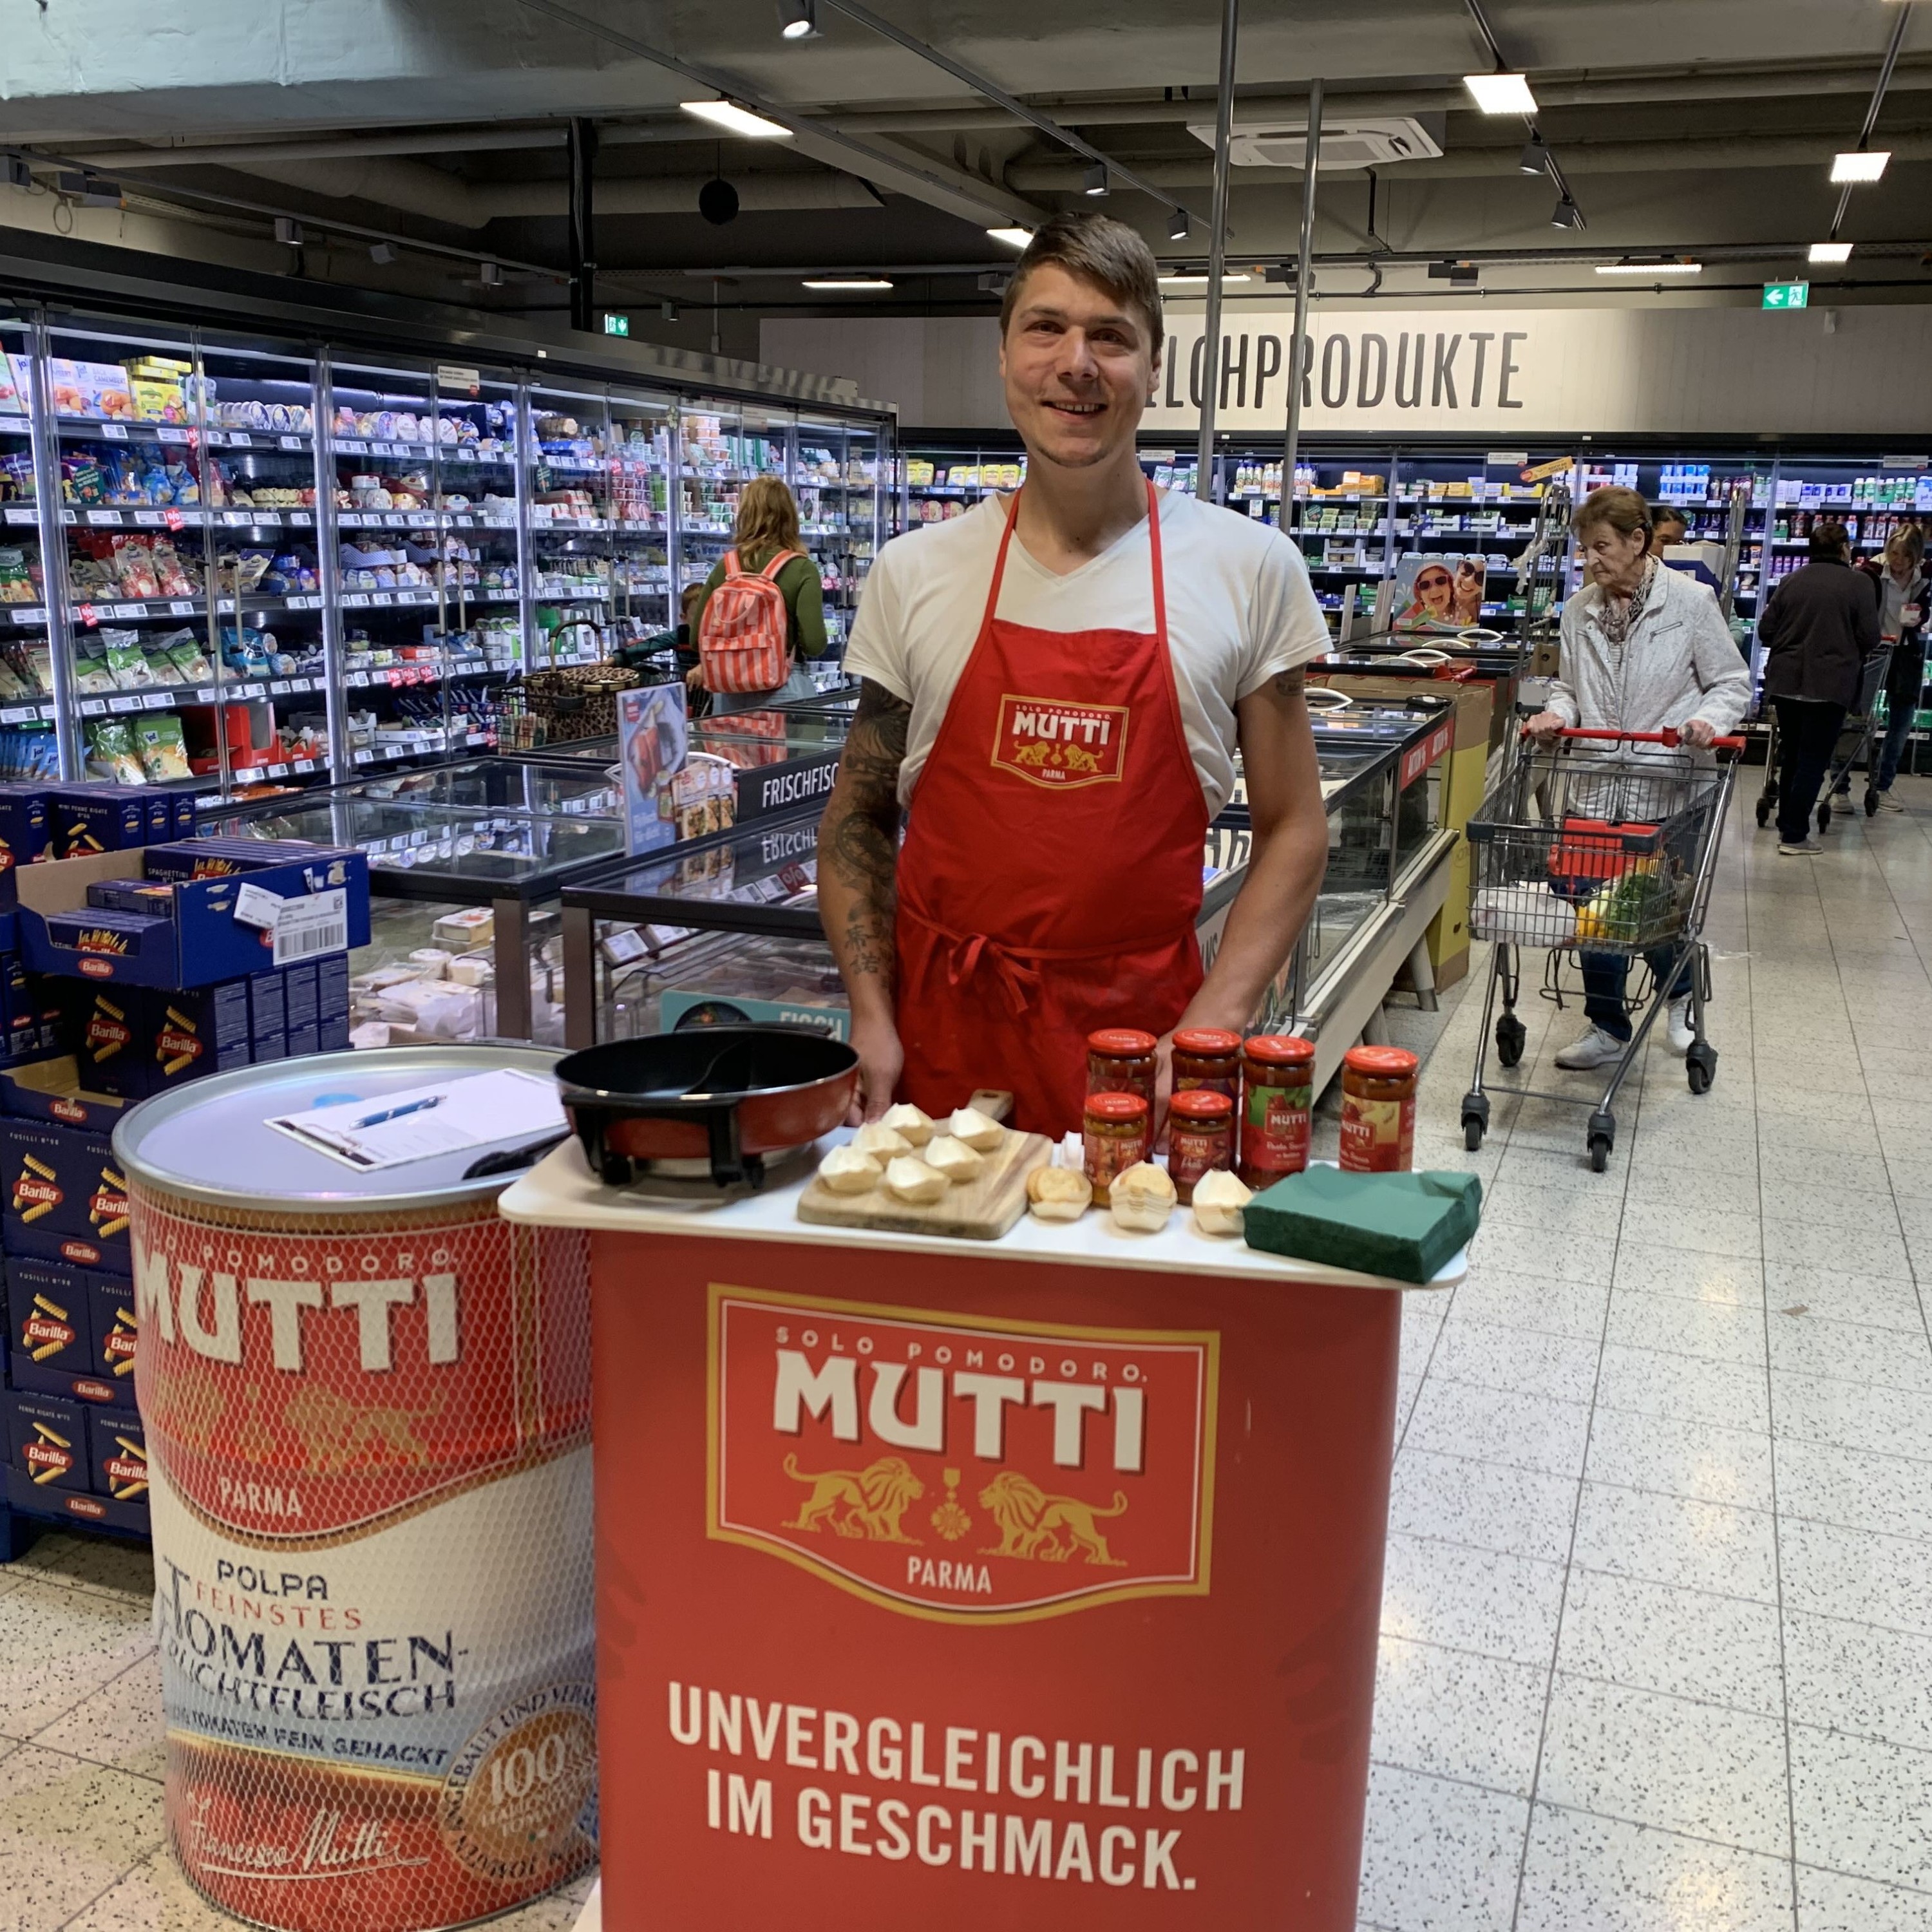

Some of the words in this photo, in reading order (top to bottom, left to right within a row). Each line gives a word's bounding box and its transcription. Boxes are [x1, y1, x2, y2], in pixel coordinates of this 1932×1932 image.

[1145, 332, 1528, 409] LCHPRODUKTE
[1016, 705, 1041, 713] SOLO
[1012, 711, 1110, 744] MUTTI
[1042, 769, 1066, 780] PARMA
[762, 762, 838, 808] FRISCHFISC
[147, 867, 189, 878] SPAGHETTINI
[82, 961, 110, 973] Barilla
[91, 1024, 126, 1041] Barilla
[162, 1036, 197, 1053] Barilla
[1271, 1113, 1306, 1124] MUTTI
[10, 1132, 37, 1142] FUSILLI
[1180, 1139, 1208, 1147] MUTTI
[19, 1184, 57, 1200] Barilla
[97, 1198, 129, 1215] Barill
[66, 1245, 96, 1260] Barilla
[19, 1272, 48, 1283] FUSILLI
[133, 1238, 458, 1372] MUTTI
[29, 1323, 69, 1341] Barilla
[775, 1326, 874, 1354] SOLO
[111, 1337, 137, 1352] Bari
[77, 1383, 110, 1398] Barilla
[19, 1405, 35, 1414] PENNE
[774, 1349, 1145, 1472] MUTTI
[100, 1419, 118, 1428] PENNE
[29, 1446, 68, 1466] Barilla
[220, 1477, 304, 1517] PARMA
[70, 1501, 103, 1515] Barilla
[216, 1558, 328, 1600] POLPA
[908, 1556, 992, 1593] PARMA
[196, 1580, 362, 1631] FEINSTES
[332, 1737, 448, 1766] GEHACKT
[668, 1681, 1245, 1812] UNVERGLEICHLICH
[707, 1768, 772, 1839] IM
[797, 1786, 1197, 1890] GESCHMACK.
